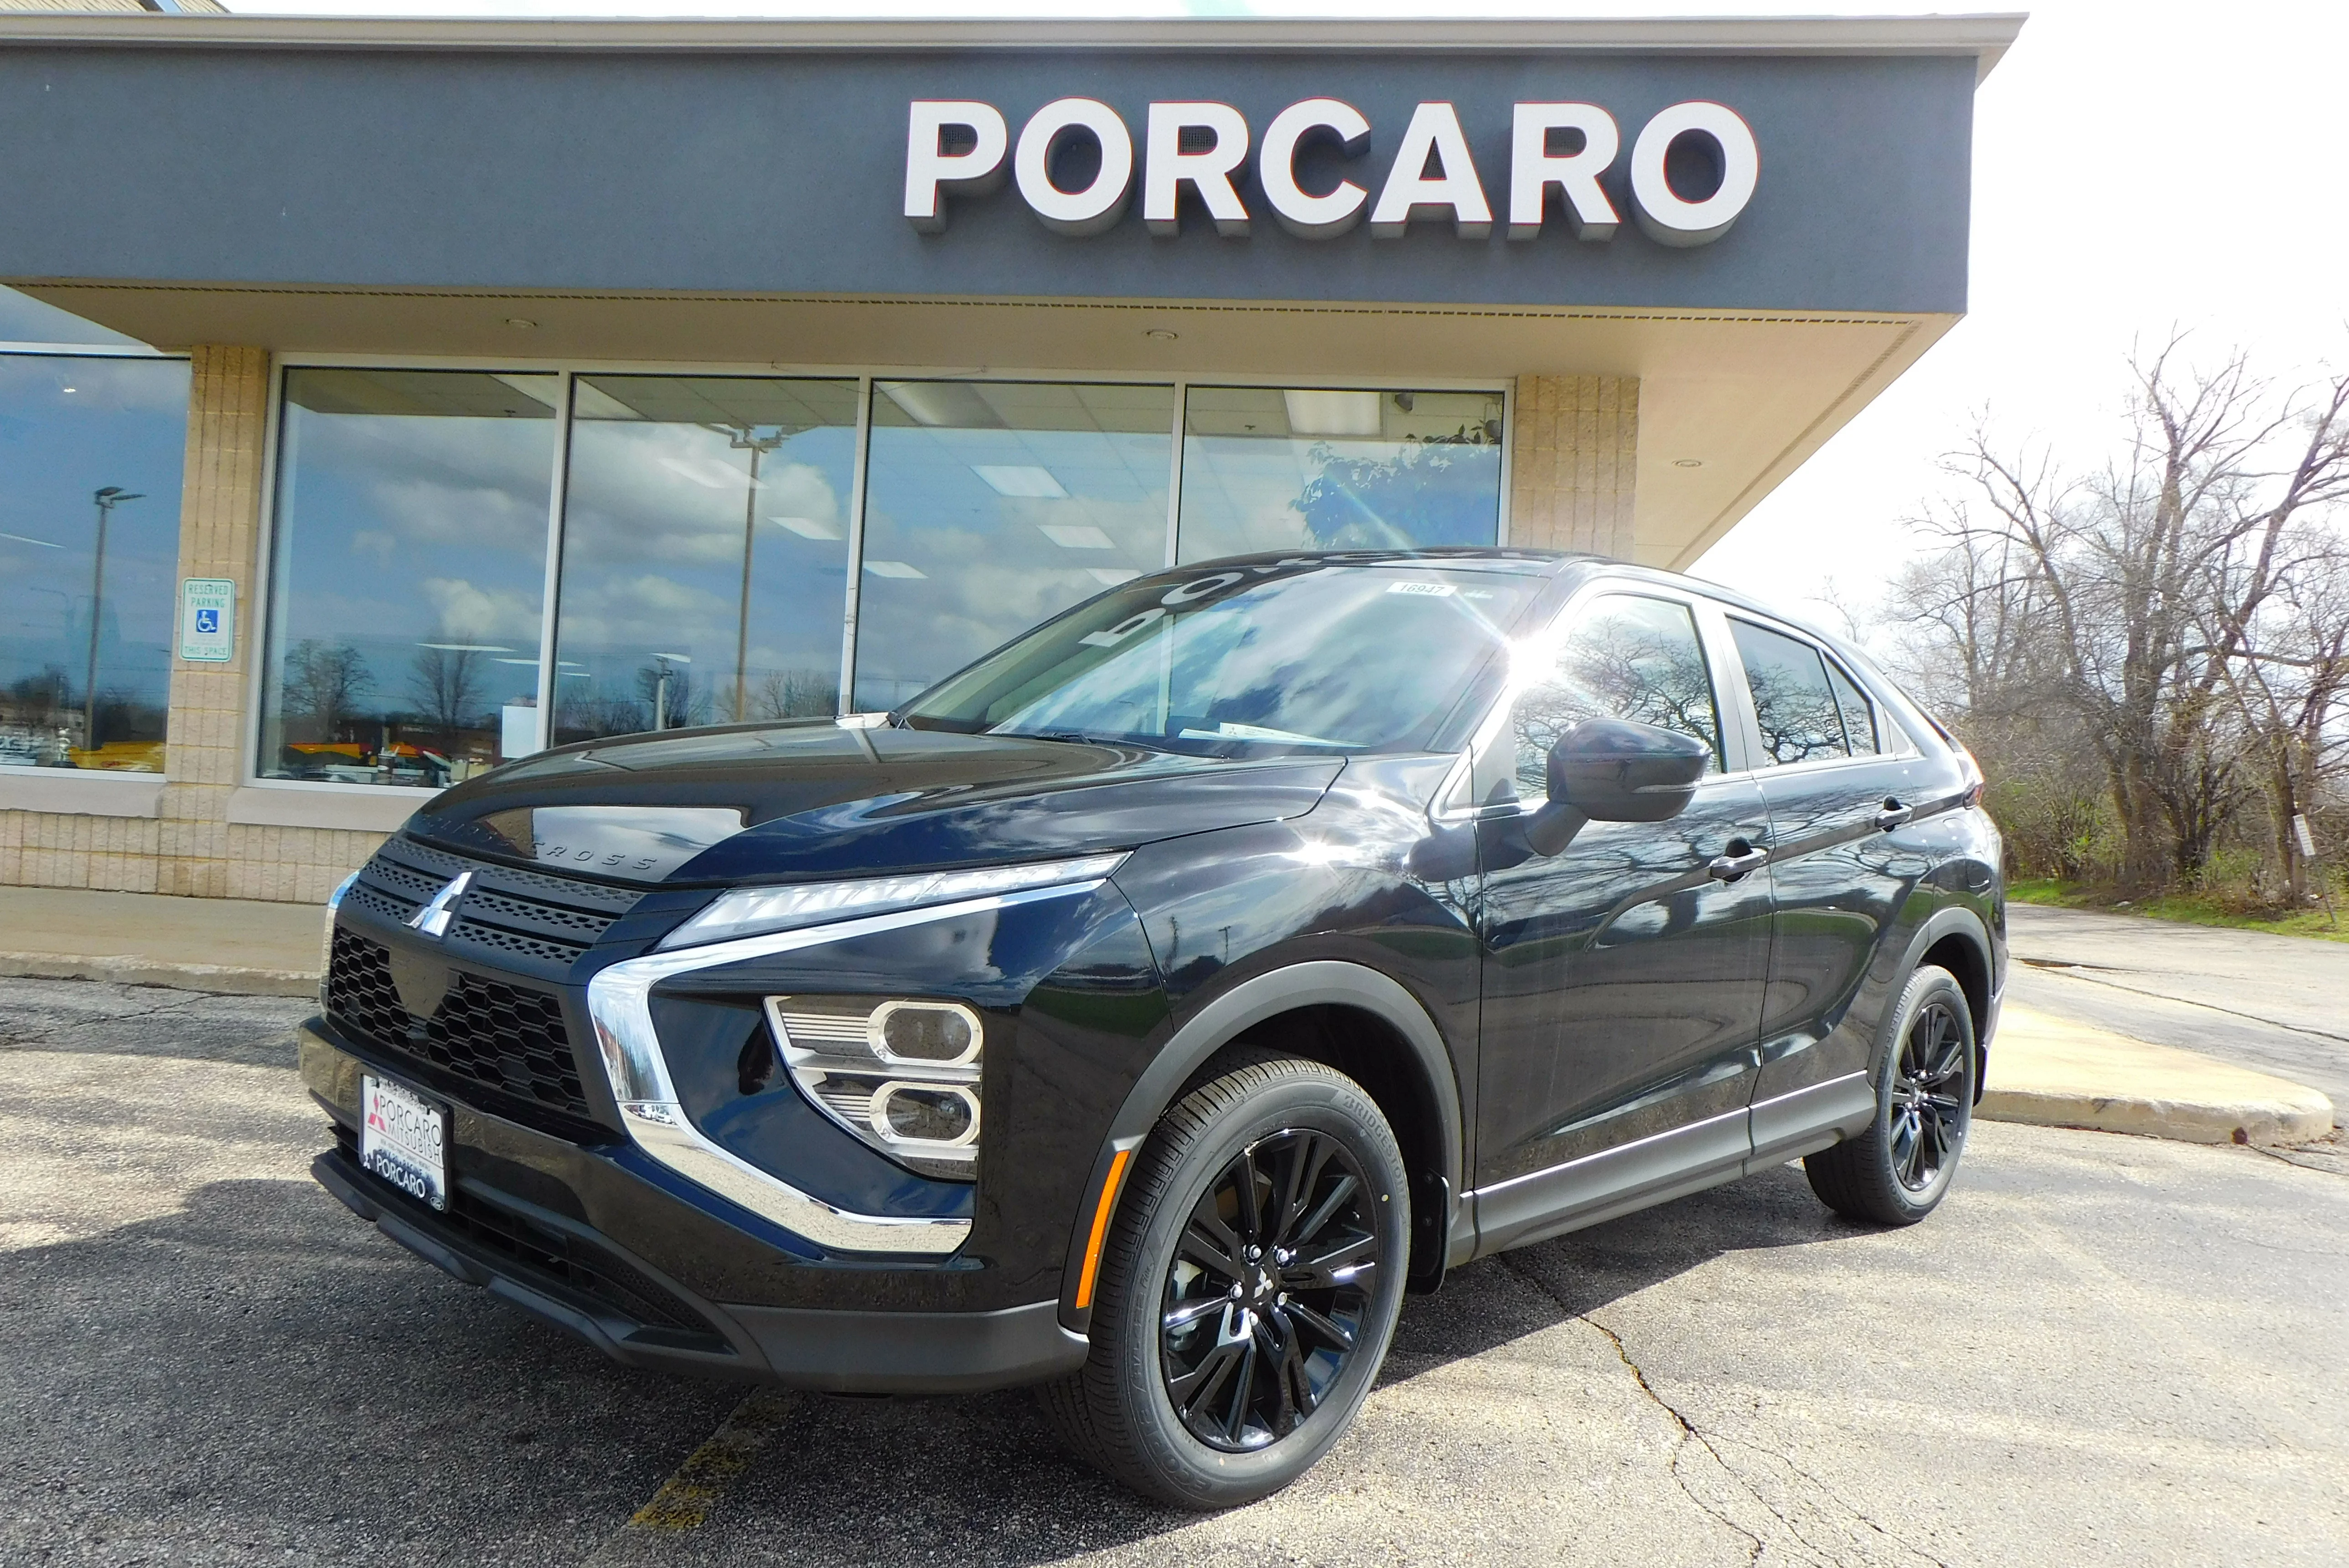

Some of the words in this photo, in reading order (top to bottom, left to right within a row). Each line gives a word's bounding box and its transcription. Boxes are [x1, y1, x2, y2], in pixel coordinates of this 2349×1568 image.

[904, 96, 1760, 233] PORCARO
[188, 584, 228, 595] RESERVED
[1400, 583, 1445, 594] 16947
[191, 598, 225, 608] PARKING
[185, 646, 201, 655] THIS
[205, 647, 227, 655] SPACE
[380, 1095, 442, 1147] PORCARO
[388, 1122, 441, 1163] MITSUBISH
[376, 1154, 425, 1198] PORCARO
